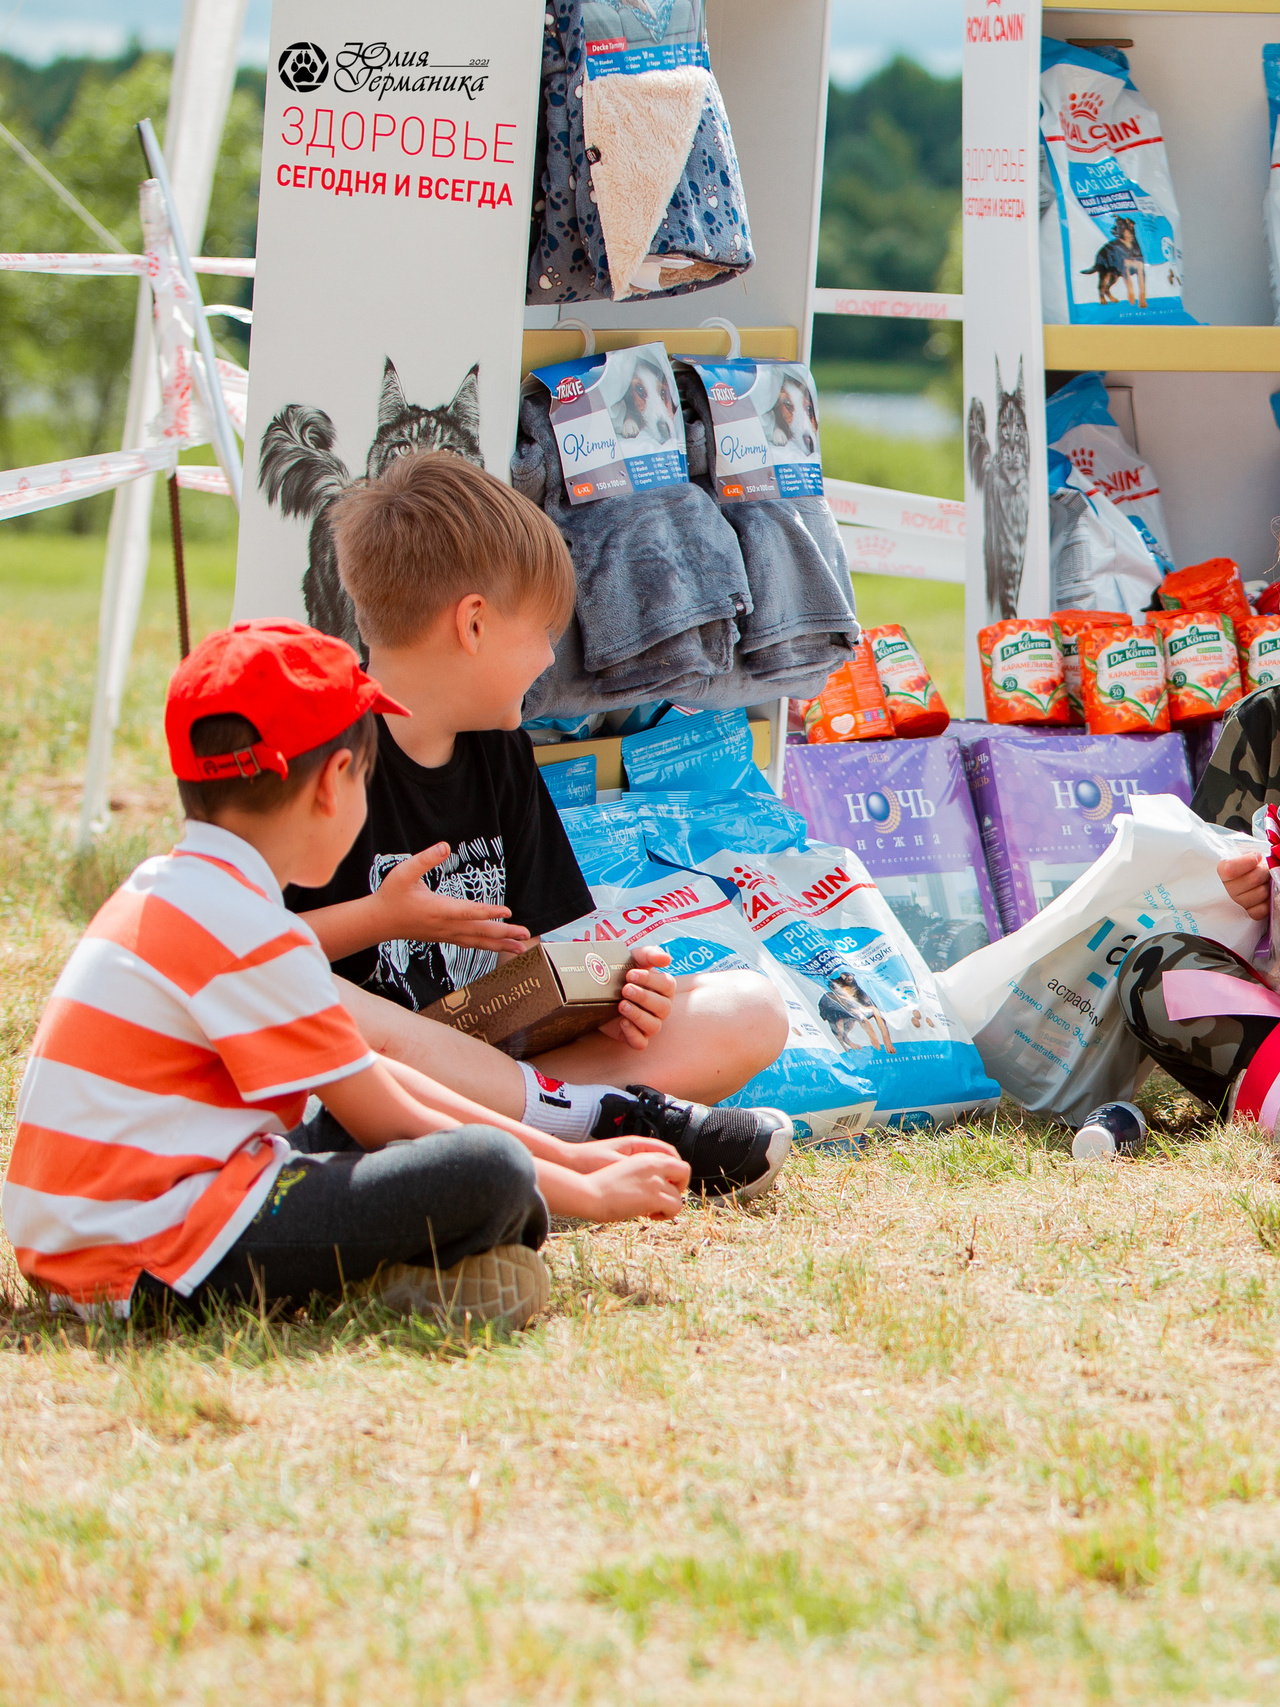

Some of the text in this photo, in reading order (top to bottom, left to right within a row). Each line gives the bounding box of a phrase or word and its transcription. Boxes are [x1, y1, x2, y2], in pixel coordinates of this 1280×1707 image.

[967, 14, 1023, 43] ROYAL CANIN
[592, 43, 608, 52] Decke
[281, 106, 517, 163] ЗДОРОВЬЕ
[965, 149, 1025, 188] ЗДОРОВЬЕ
[277, 164, 513, 209] СЕГОДНЯ И ВСЕГДА
[1000, 199, 1025, 221] ВСЕГДА
[557, 380, 583, 399] TRIXIE
[711, 388, 737, 401] TRIXIE
[563, 433, 616, 461] Kimmy
[721, 436, 766, 464] Kimmy
[577, 486, 590, 494] L-XL
[877, 643, 905, 659] Körner
[1003, 641, 1049, 658] Dr. Körner
[1172, 634, 1218, 652] Dr. Körner
[1261, 643, 1276, 653] Dr.
[1110, 649, 1154, 665] Dr. Körner
[1171, 655, 1223, 666] КАРАМЕЛЬНЫЕ
[1001, 662, 1054, 672] КАРАМЕЛЬНЫЕ
[1108, 670, 1158, 679] КАРАМЕЛЬНЫЕ
[622, 885, 700, 925] CANIN
[1007, 980, 1071, 1032] Разумно. Просто.
[889, 1056, 909, 1064] HEALTH
[912, 1053, 944, 1061] NUTRITION
